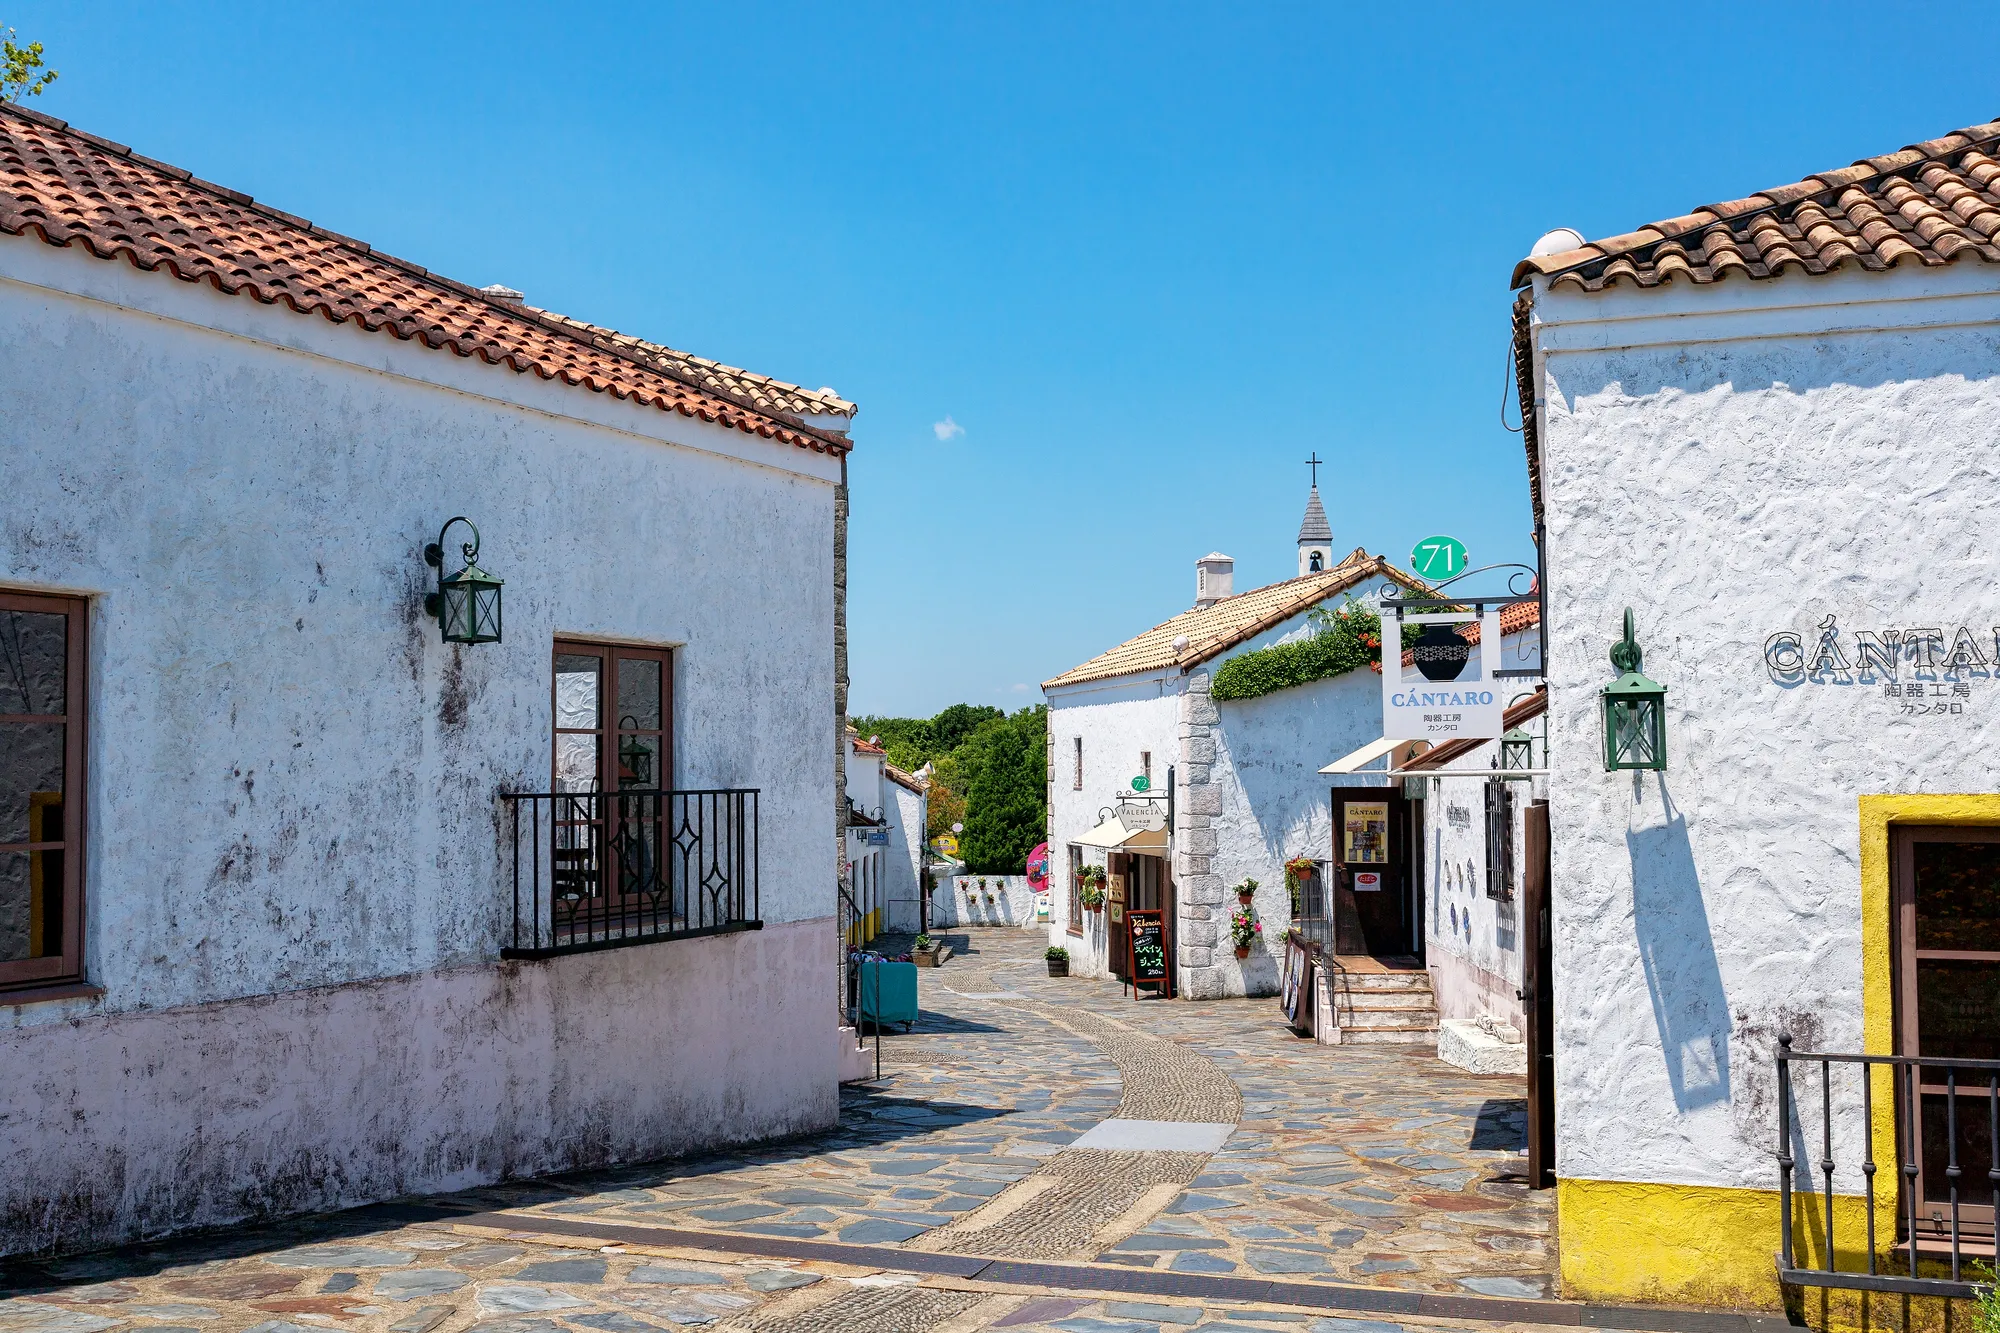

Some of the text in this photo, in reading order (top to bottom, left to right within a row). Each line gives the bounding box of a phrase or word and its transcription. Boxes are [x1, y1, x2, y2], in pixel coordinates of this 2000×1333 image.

[1422, 544, 1453, 573] 71
[1764, 614, 2000, 673] CÁNTA
[1884, 682, 1971, 698] 陶器工房
[1391, 687, 1494, 707] CÁNTARO
[1900, 702, 1963, 715] カンタロ
[1423, 713, 1462, 723] 陶器工房
[1427, 724, 1458, 732] カンタロ
[1134, 778, 1147, 789] 72
[1121, 808, 1159, 816] VALENCIA
